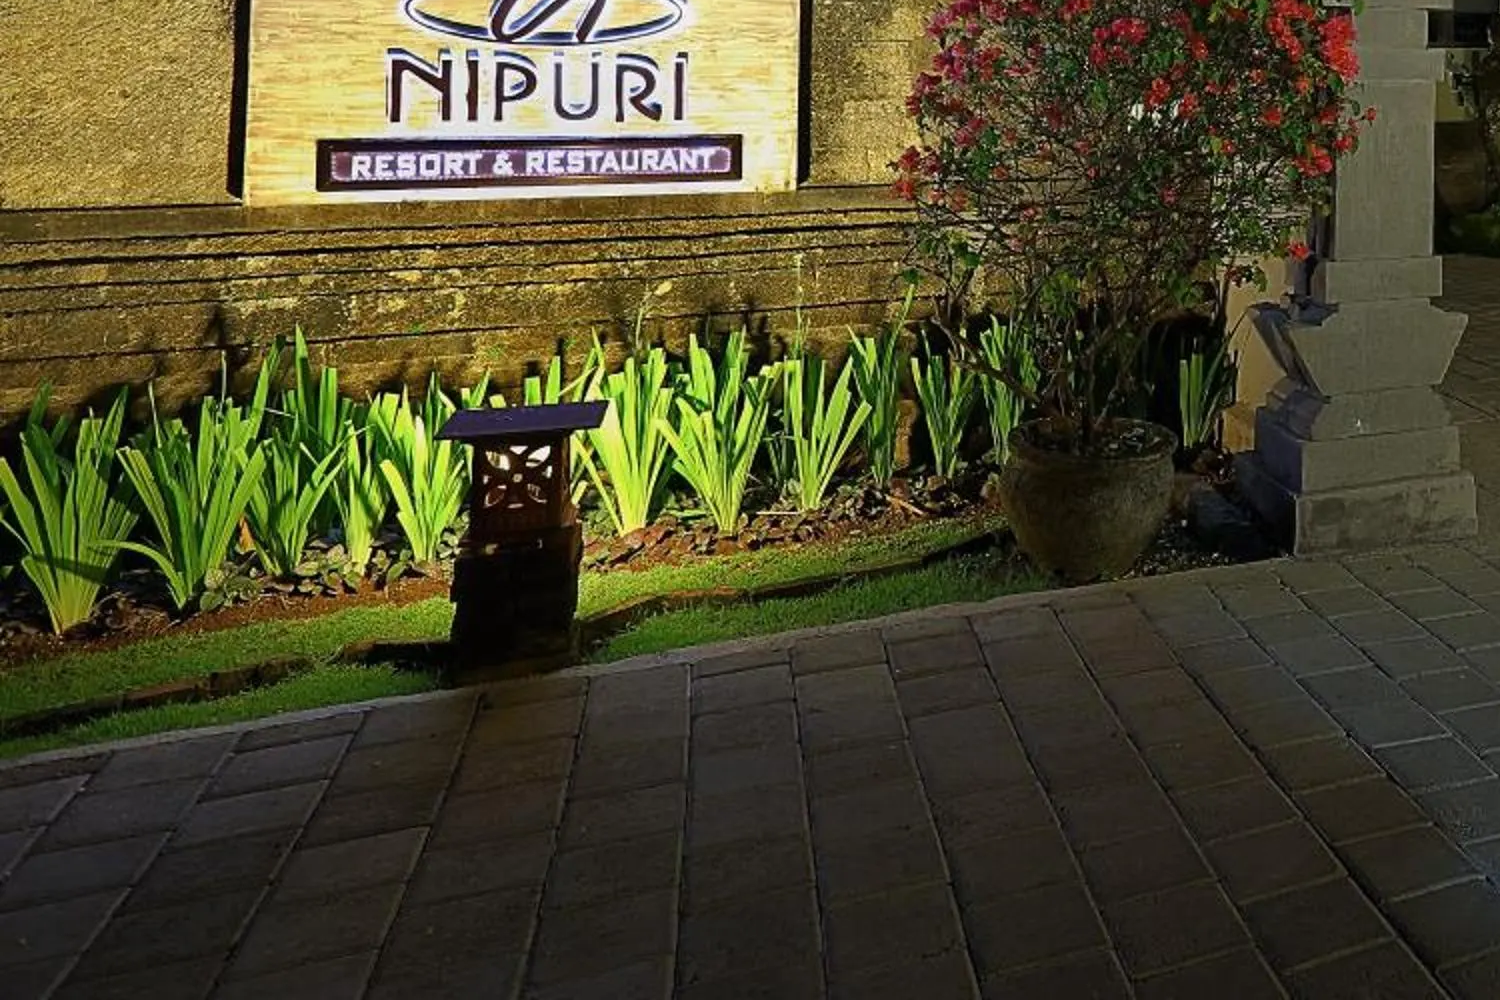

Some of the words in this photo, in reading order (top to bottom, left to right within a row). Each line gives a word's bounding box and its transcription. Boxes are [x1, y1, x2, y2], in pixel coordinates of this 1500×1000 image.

[387, 47, 688, 123] NIPURI
[350, 152, 482, 181] RESORT
[492, 150, 514, 176] &
[525, 146, 716, 175] RESTAURANT
